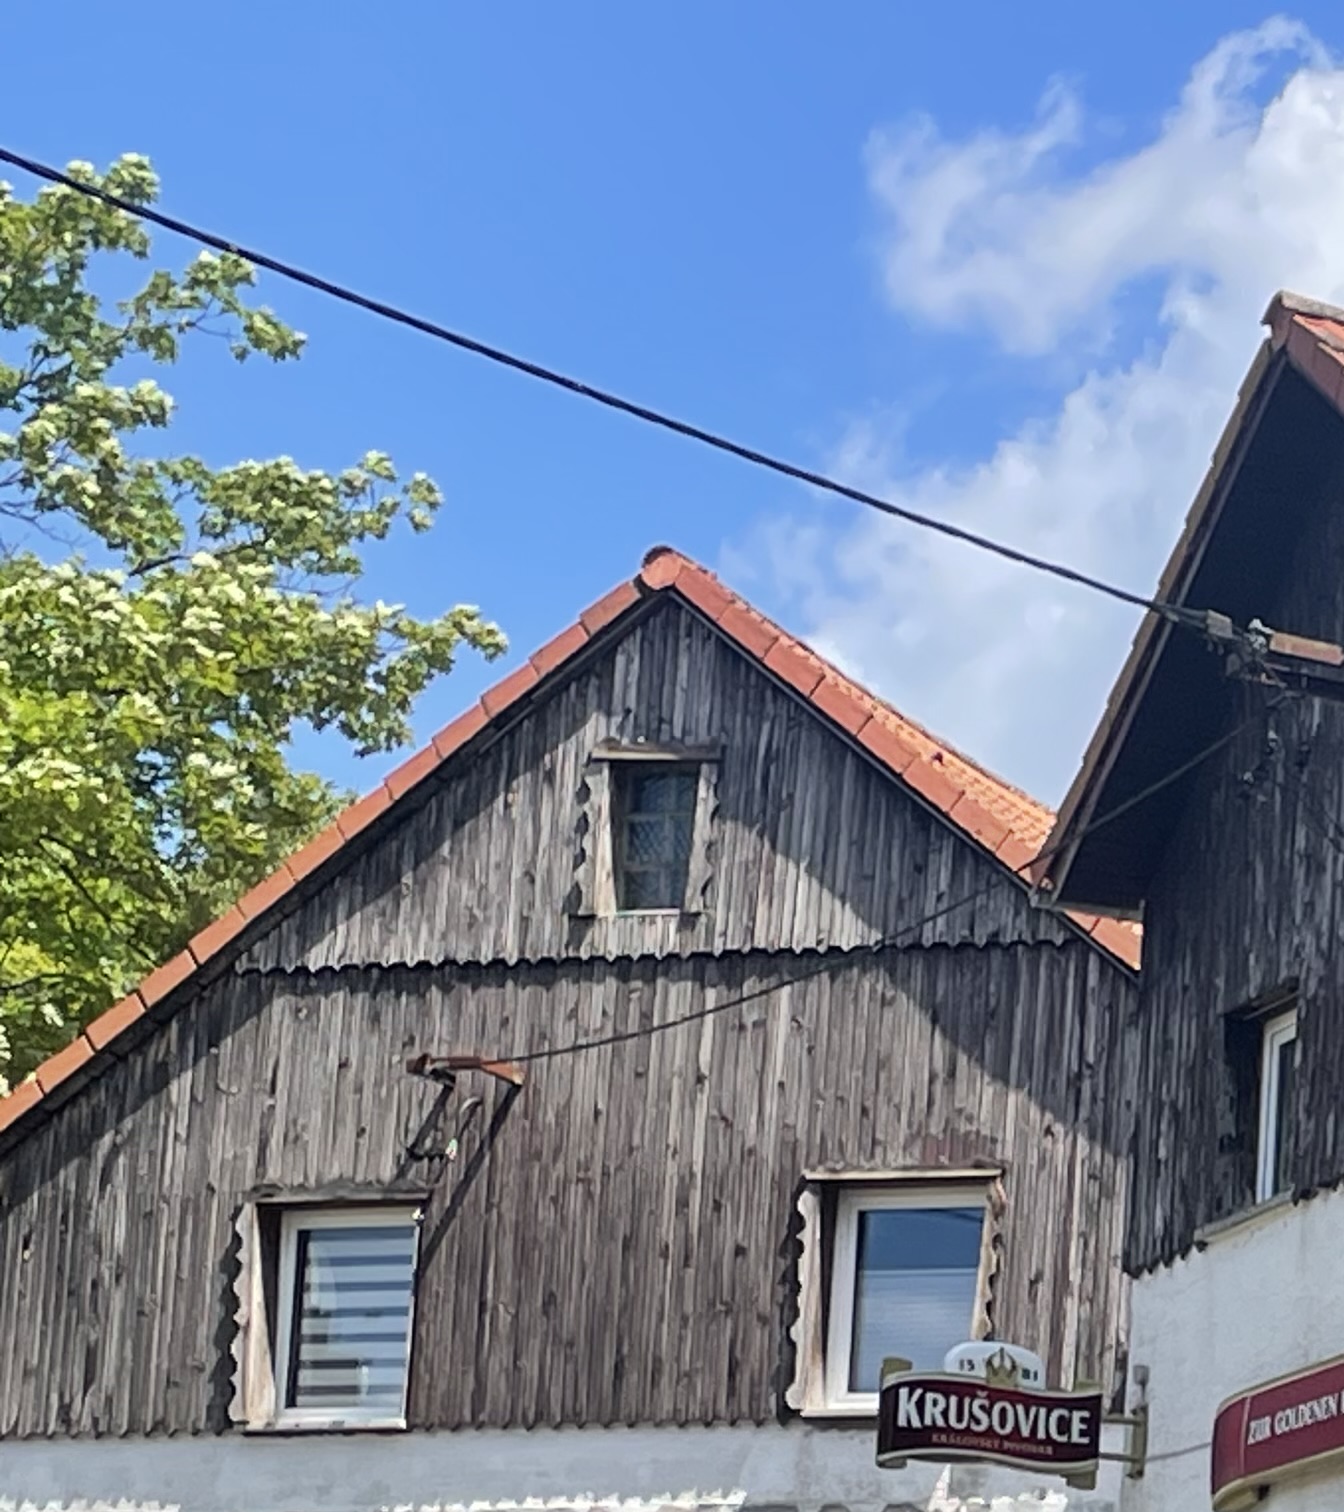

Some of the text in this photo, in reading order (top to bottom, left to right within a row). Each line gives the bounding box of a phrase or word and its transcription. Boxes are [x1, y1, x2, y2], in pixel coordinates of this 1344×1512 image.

[897, 1386, 1091, 1444] KRUŠOVICE
[1247, 1416, 1272, 1445] ZUR
[1275, 1393, 1339, 1435] GOLDENEN
